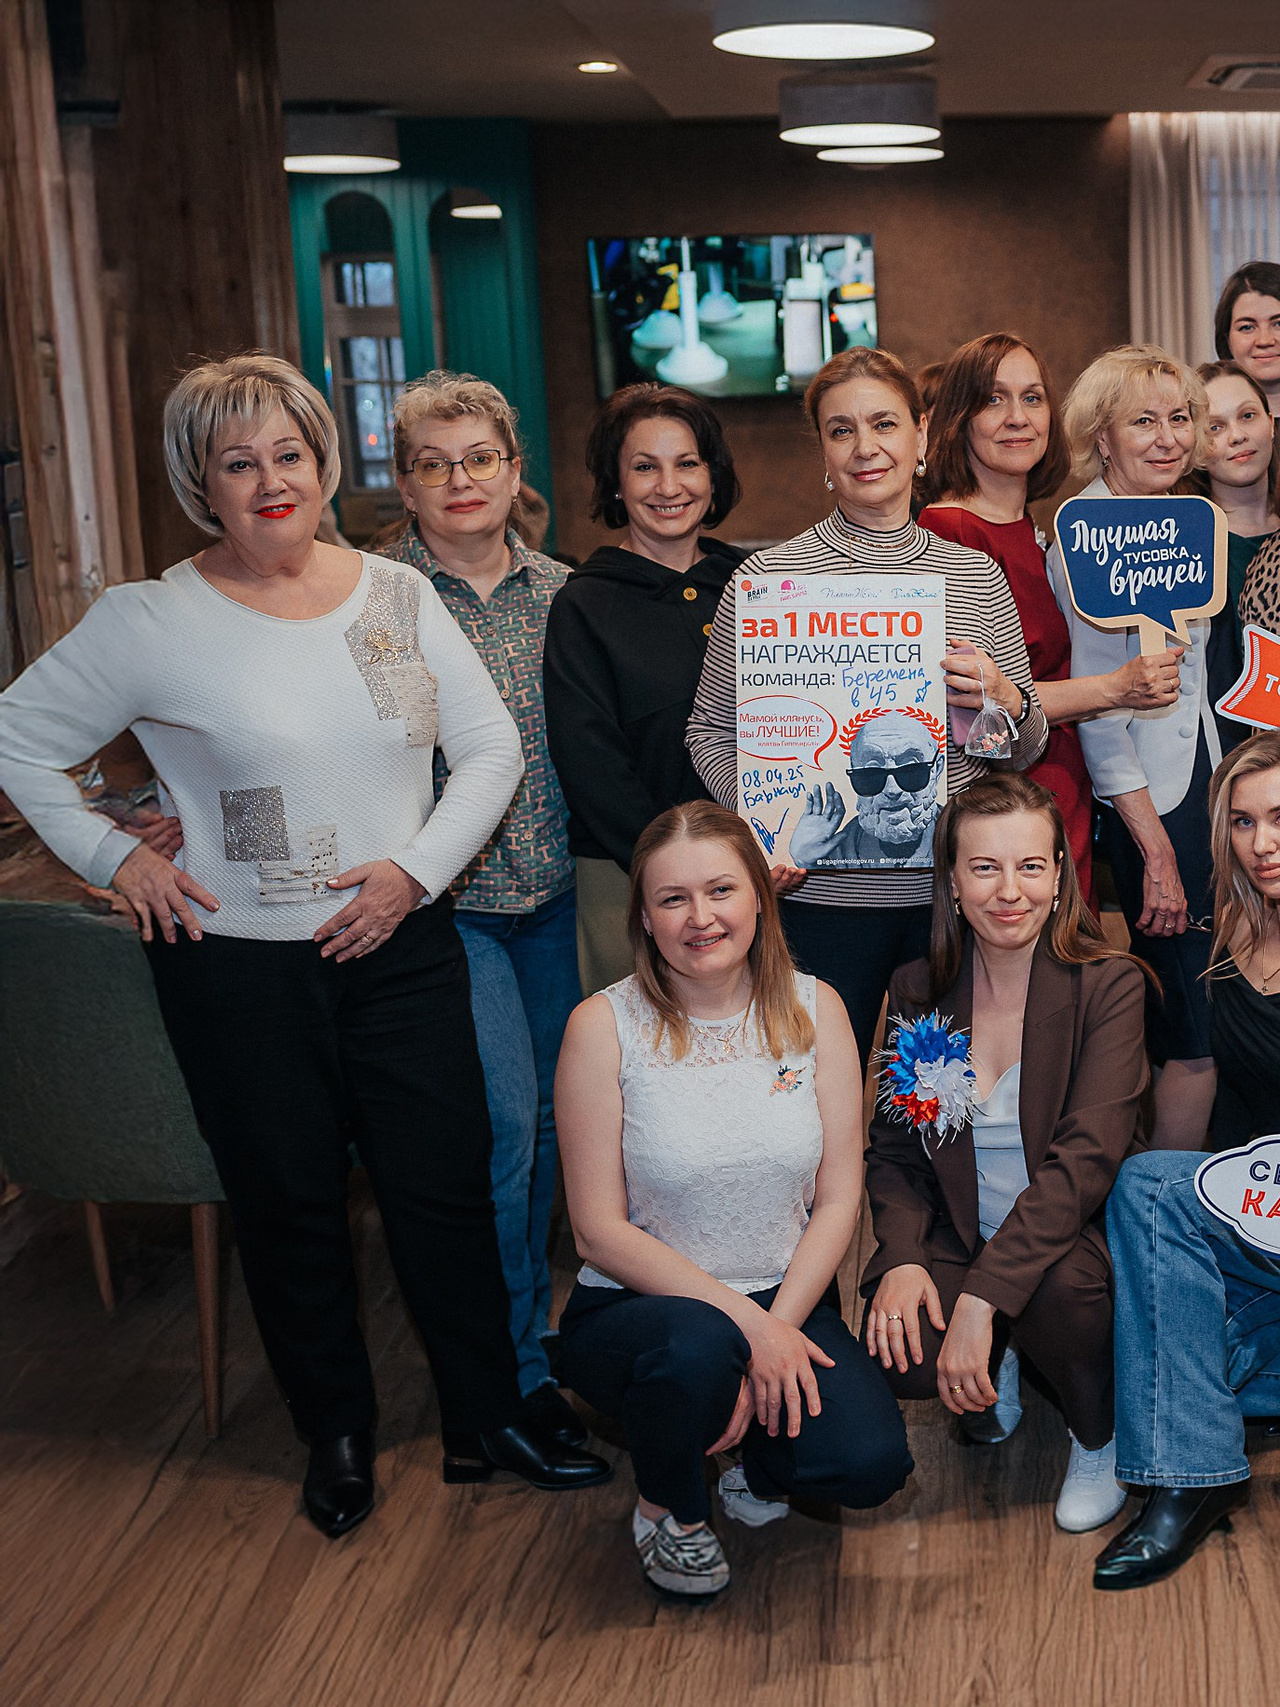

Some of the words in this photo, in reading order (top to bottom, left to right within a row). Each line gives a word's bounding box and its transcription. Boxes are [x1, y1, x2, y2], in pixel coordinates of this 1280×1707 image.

[1070, 518, 1179, 566] Лучшая
[1123, 546, 1189, 565] ТУСОВКА
[1110, 553, 1207, 606] врачей
[741, 618, 778, 637] за
[784, 612, 797, 637] 1
[808, 611, 923, 638] МЕСТО
[741, 644, 921, 667] НАГРАЖДАЕТСЯ
[741, 673, 835, 689] команда:
[869, 683, 898, 706] 45
[739, 713, 777, 723] Мамой
[780, 714, 824, 724] клянусь,
[756, 725, 820, 738] ЛУЧШИЕ!
[742, 765, 803, 788] 08.04.25
[743, 783, 806, 809] Барнаул
